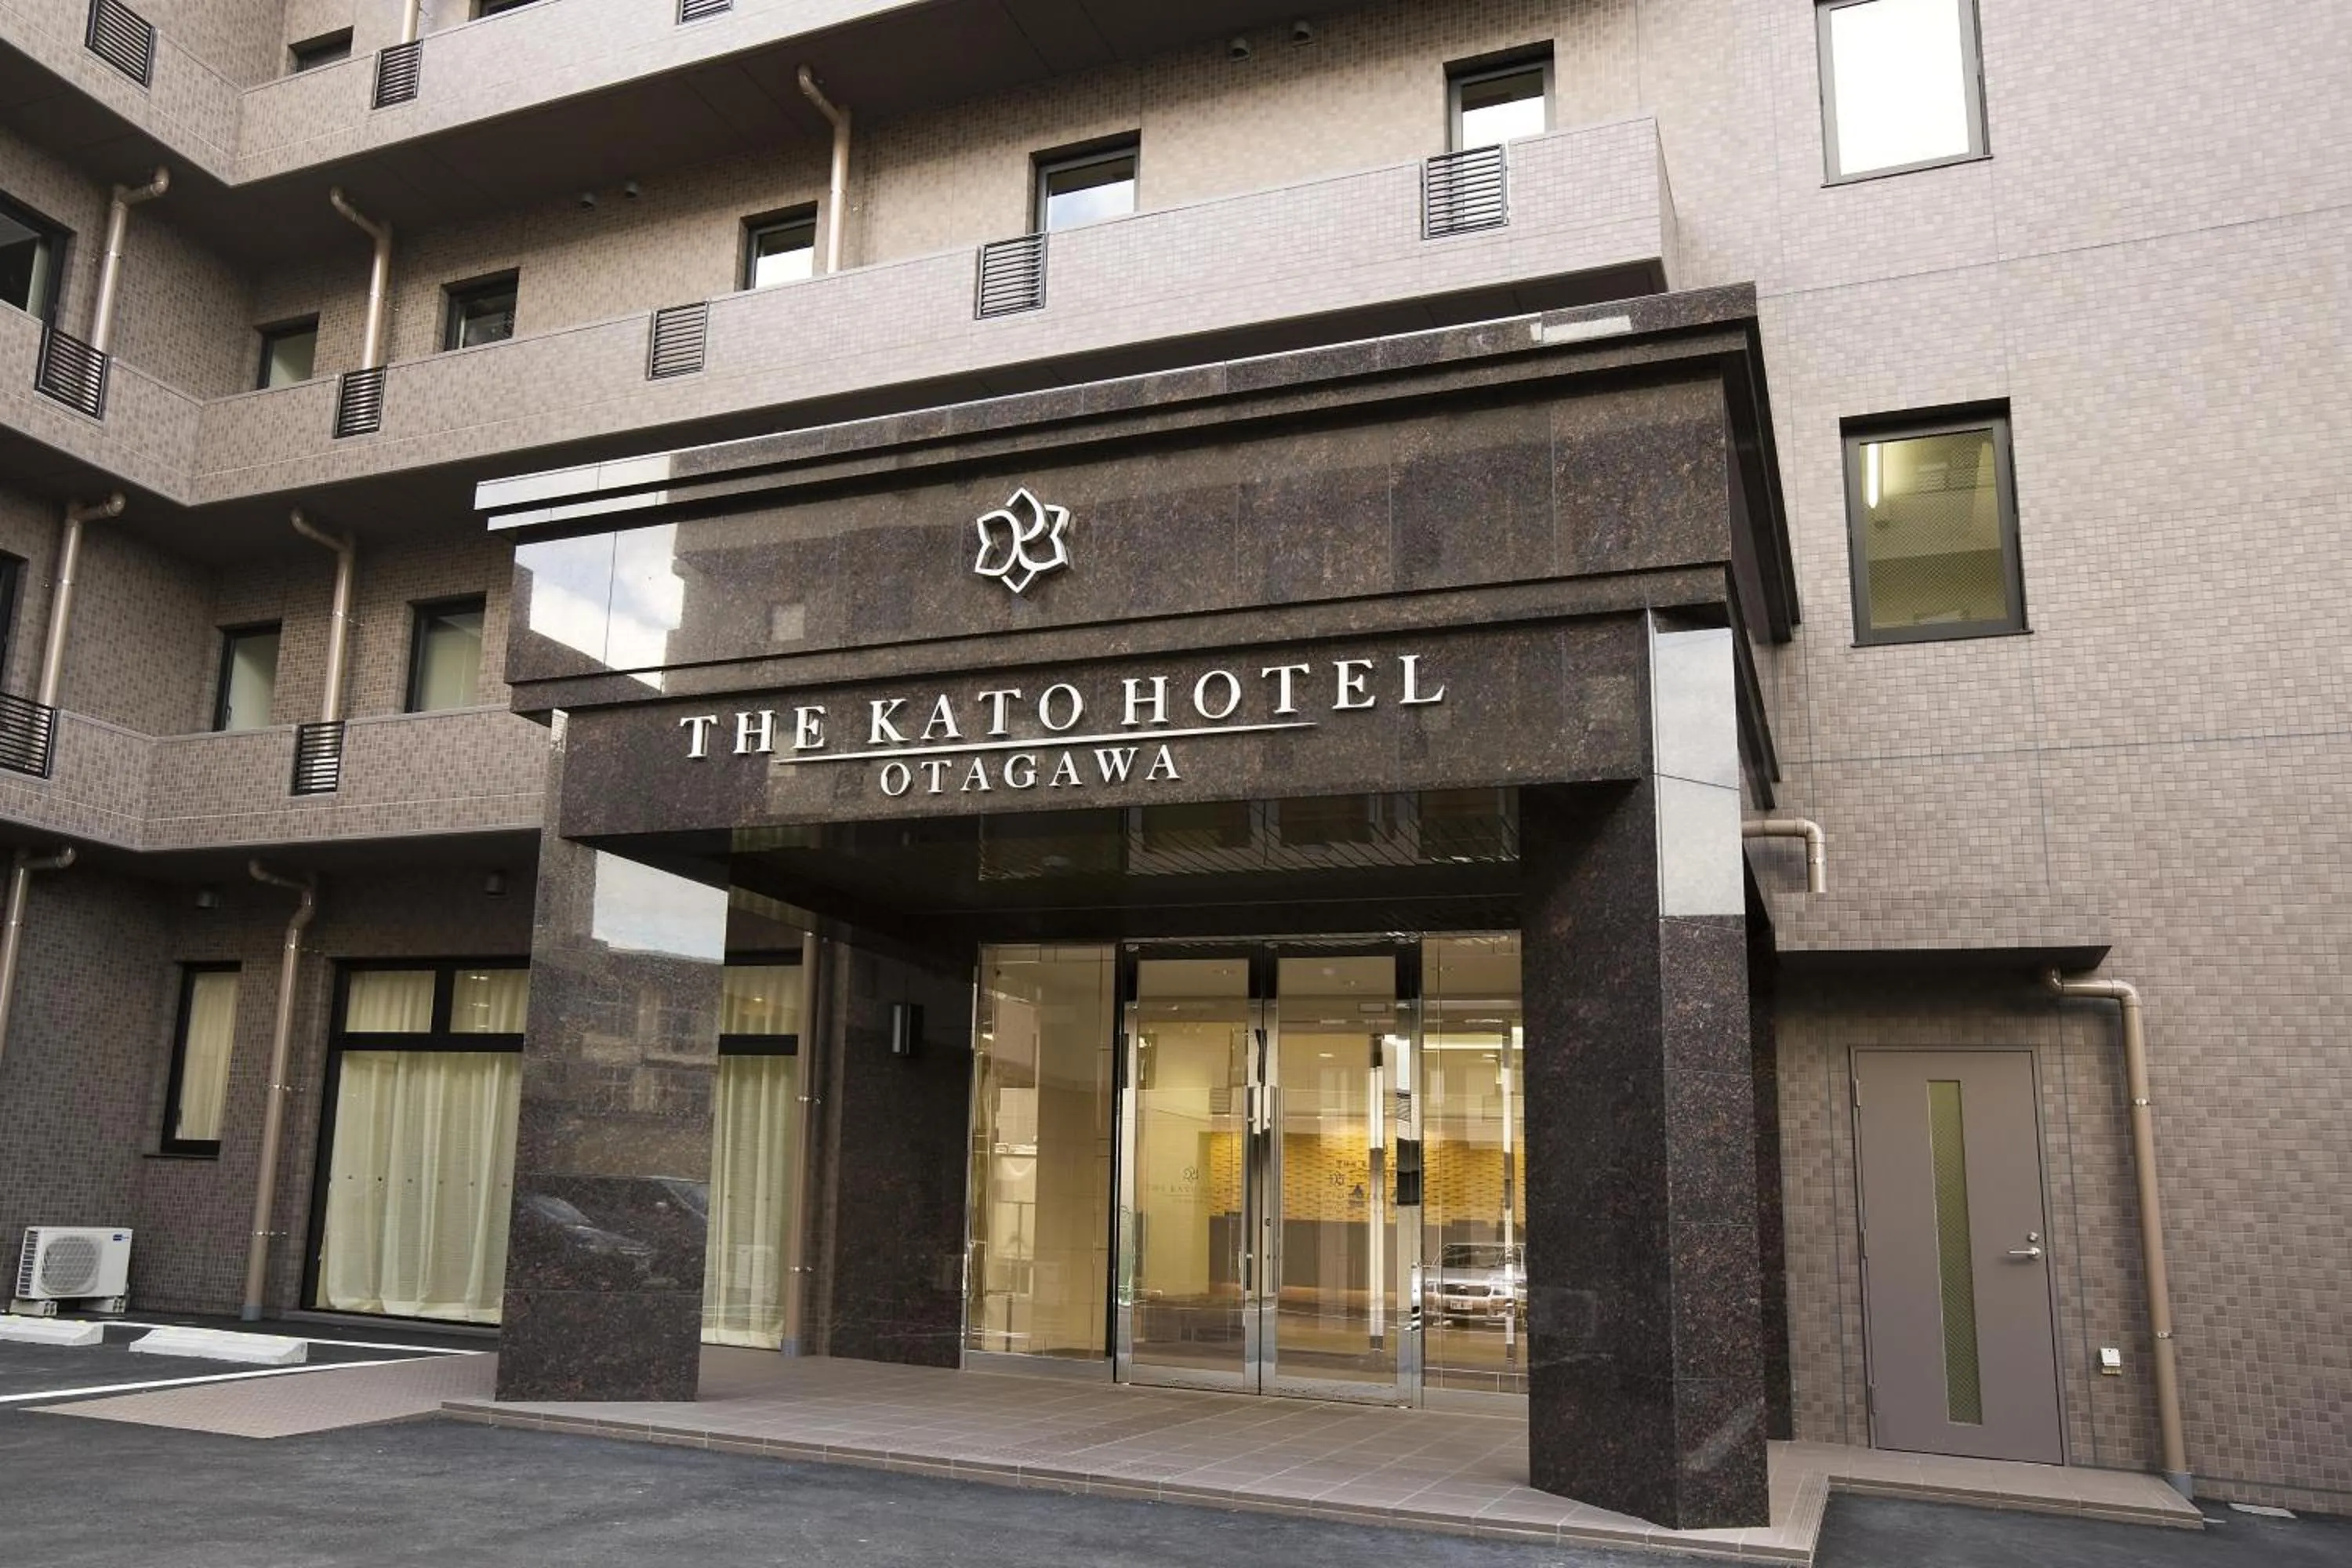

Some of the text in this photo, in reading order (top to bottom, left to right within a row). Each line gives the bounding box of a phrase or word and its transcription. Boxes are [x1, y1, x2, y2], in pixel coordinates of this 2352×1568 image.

[680, 655, 1446, 759] THE KATO HOTEL
[880, 744, 1181, 797] OTAGAWA
